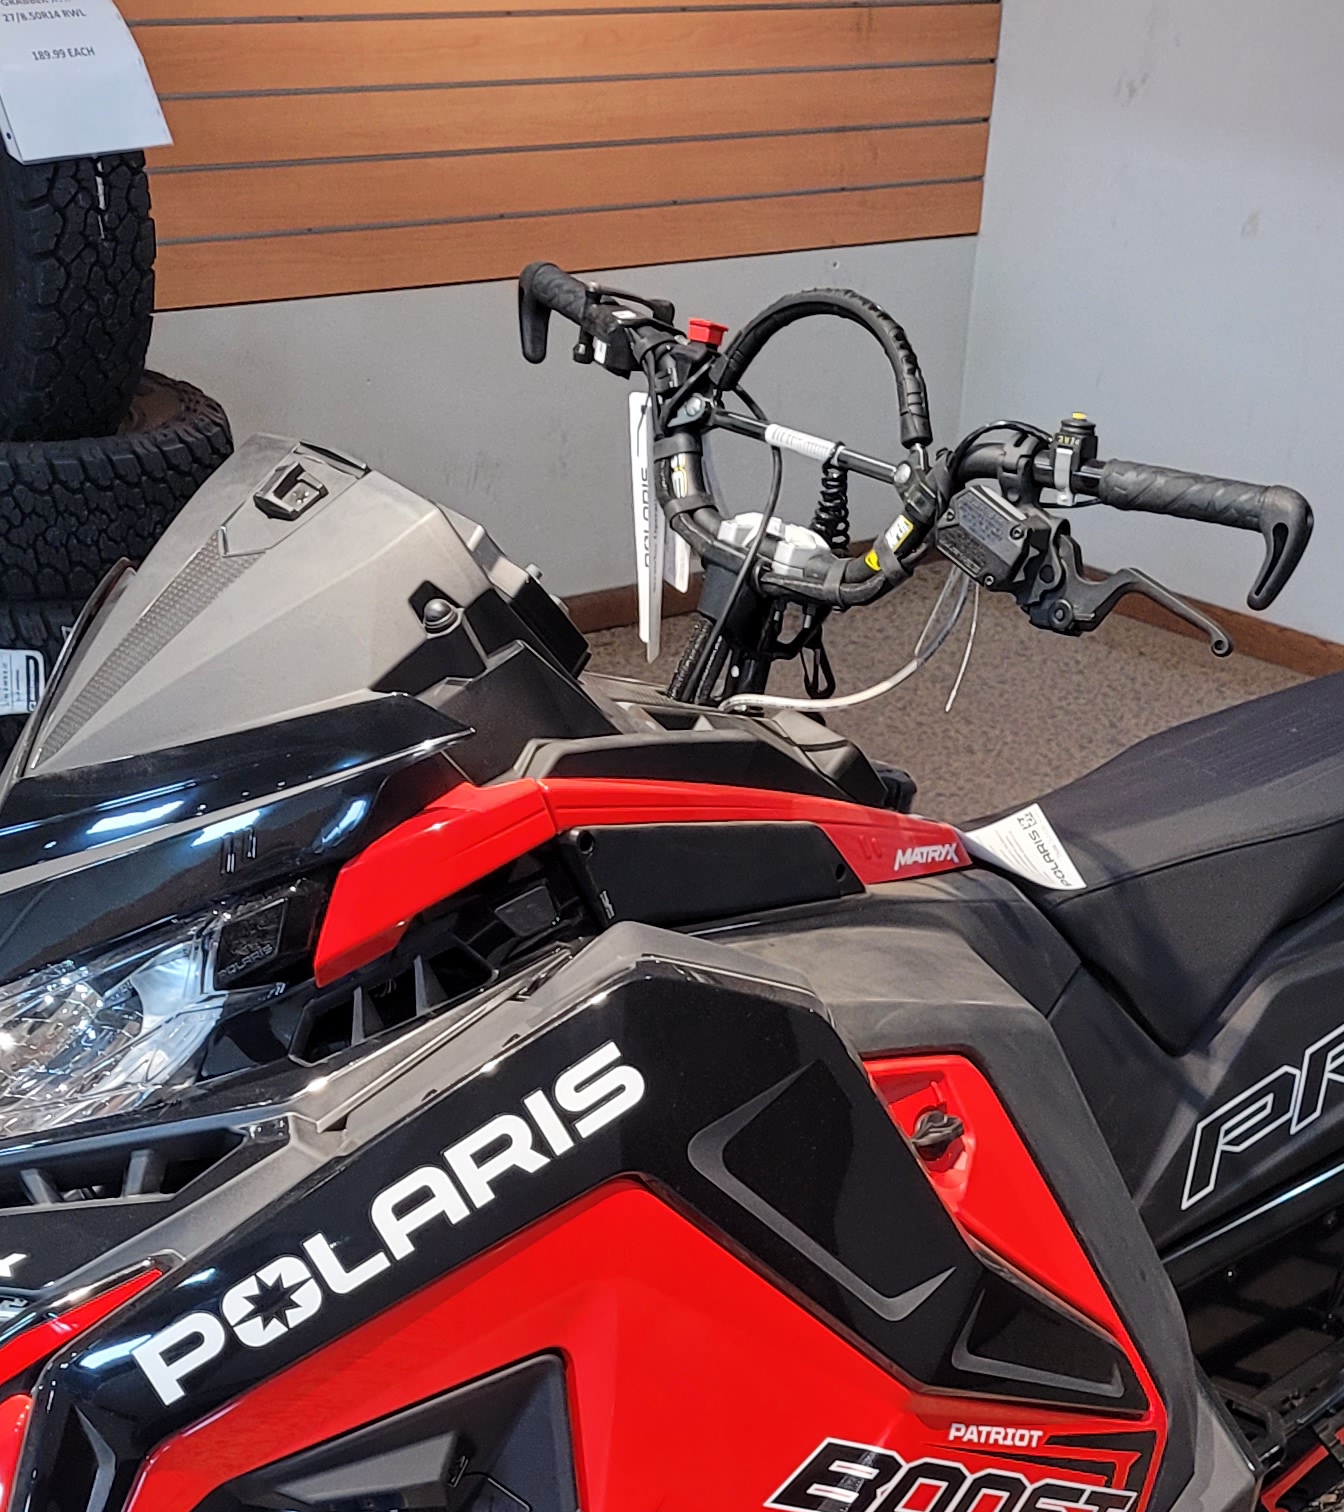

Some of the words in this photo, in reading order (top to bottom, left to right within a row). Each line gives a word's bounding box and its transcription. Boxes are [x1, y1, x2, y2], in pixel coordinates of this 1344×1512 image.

[61, 8, 87, 18] RWL
[32, 48, 66, 61] 189.99
[67, 47, 96, 58] EACH
[893, 842, 960, 872] MATRYX
[1027, 829, 1073, 888] POLARIS
[130, 1040, 646, 1407] POLARIS
[949, 1422, 1044, 1449] PATRIOT
